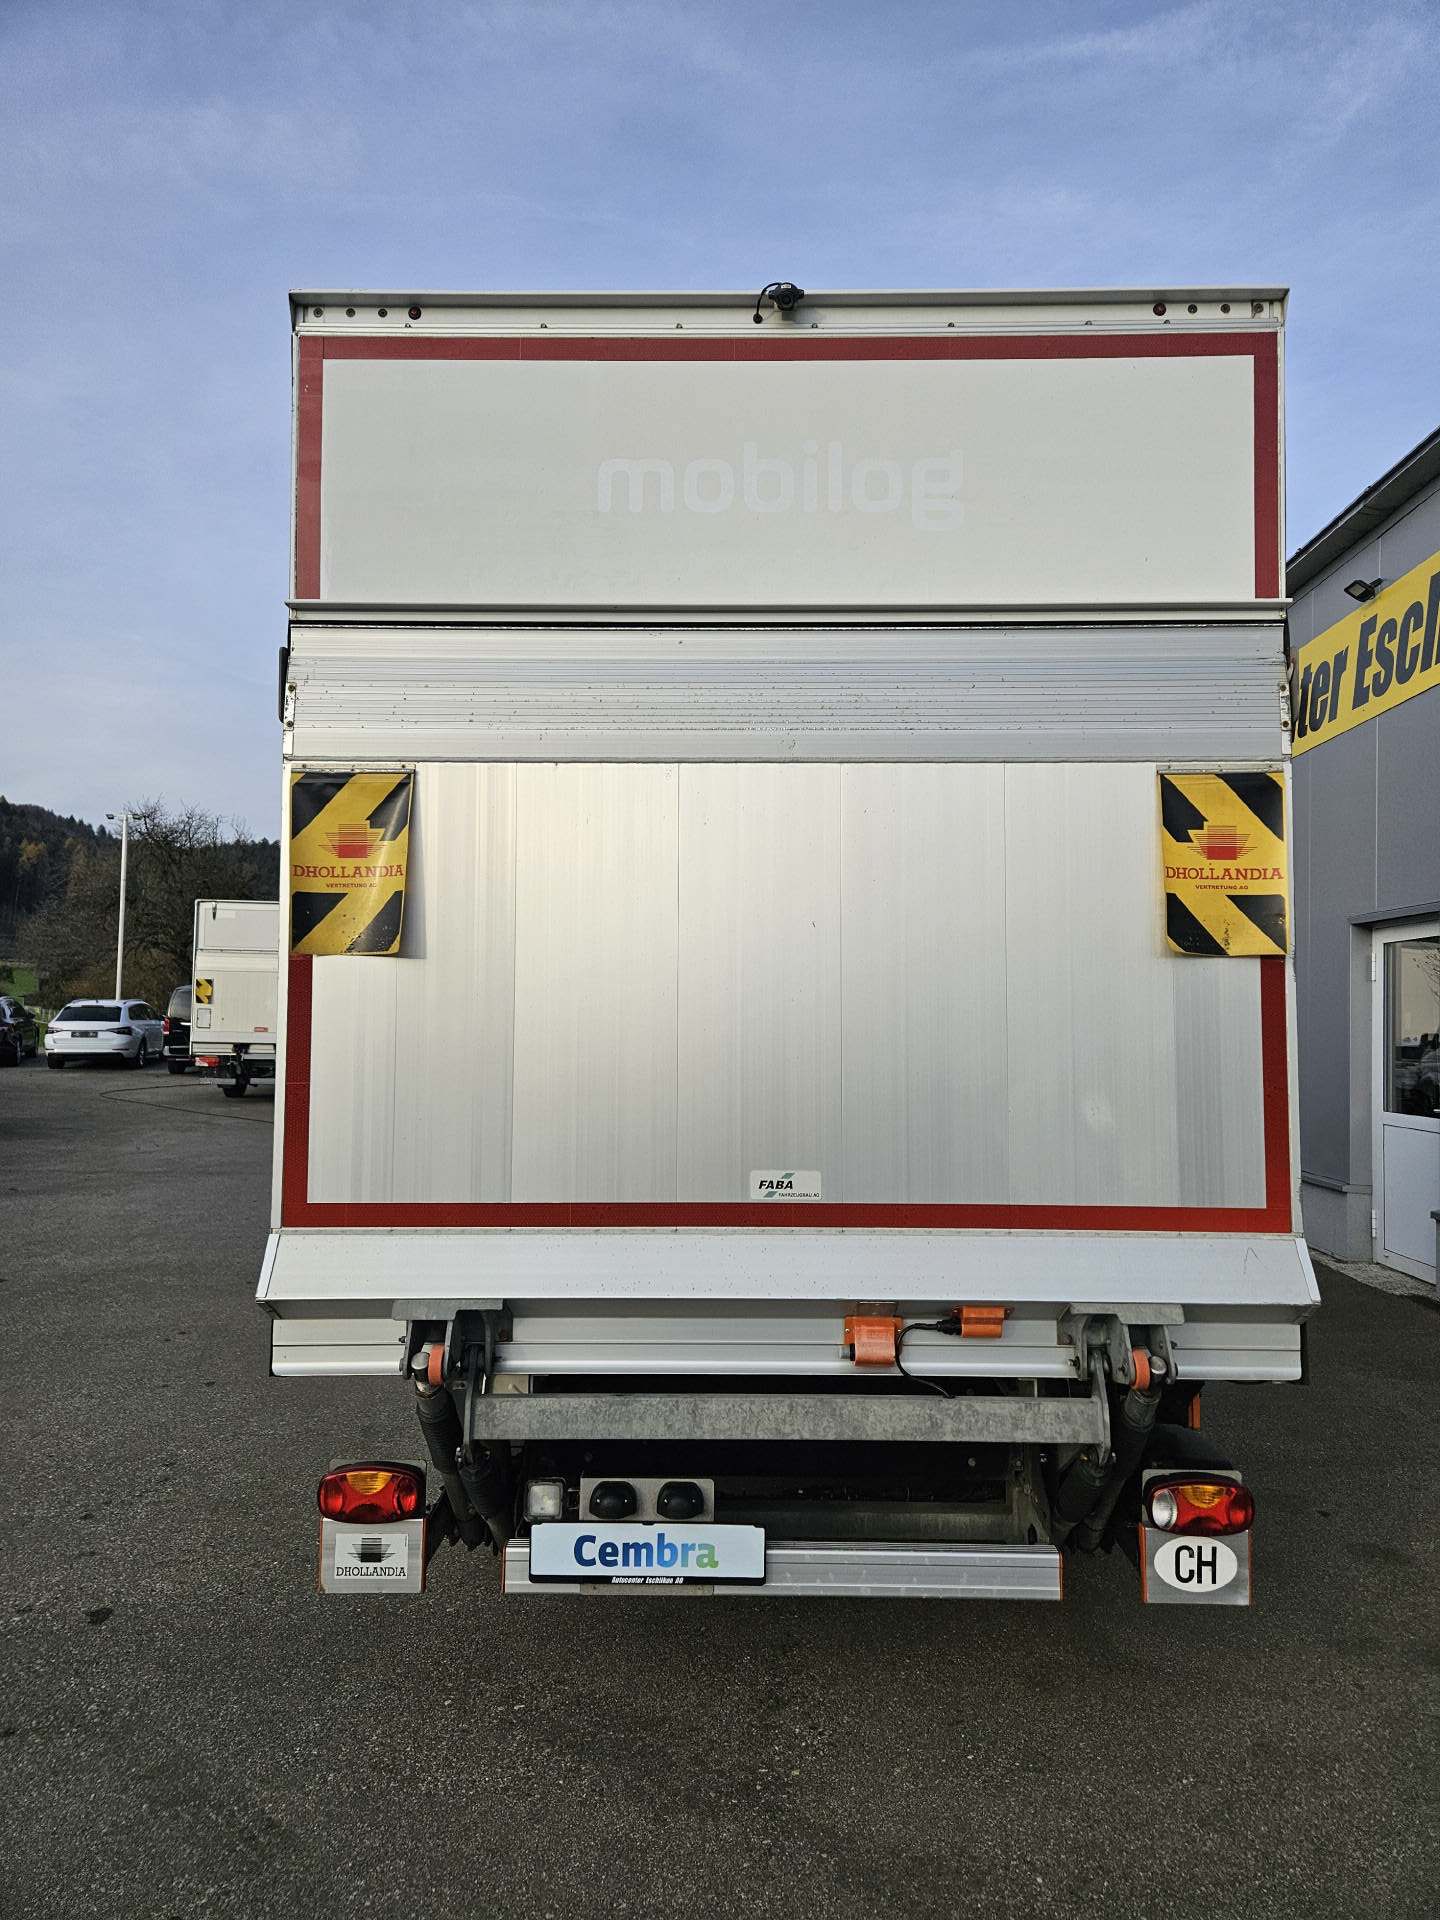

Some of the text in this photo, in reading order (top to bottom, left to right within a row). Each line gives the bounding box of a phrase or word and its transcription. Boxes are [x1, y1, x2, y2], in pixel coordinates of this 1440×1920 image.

[598, 440, 964, 531] mobilog
[1290, 645, 1349, 743] ter
[292, 864, 404, 879] DHOLLANDIA
[1165, 866, 1284, 881] DHOLLANDIA
[758, 1180, 793, 1190] FABA
[573, 1532, 719, 1569] Cembra
[335, 1566, 407, 1577] DHOLLANDIA
[1174, 1544, 1218, 1585] CH
[611, 1575, 645, 1584] Autocenter
